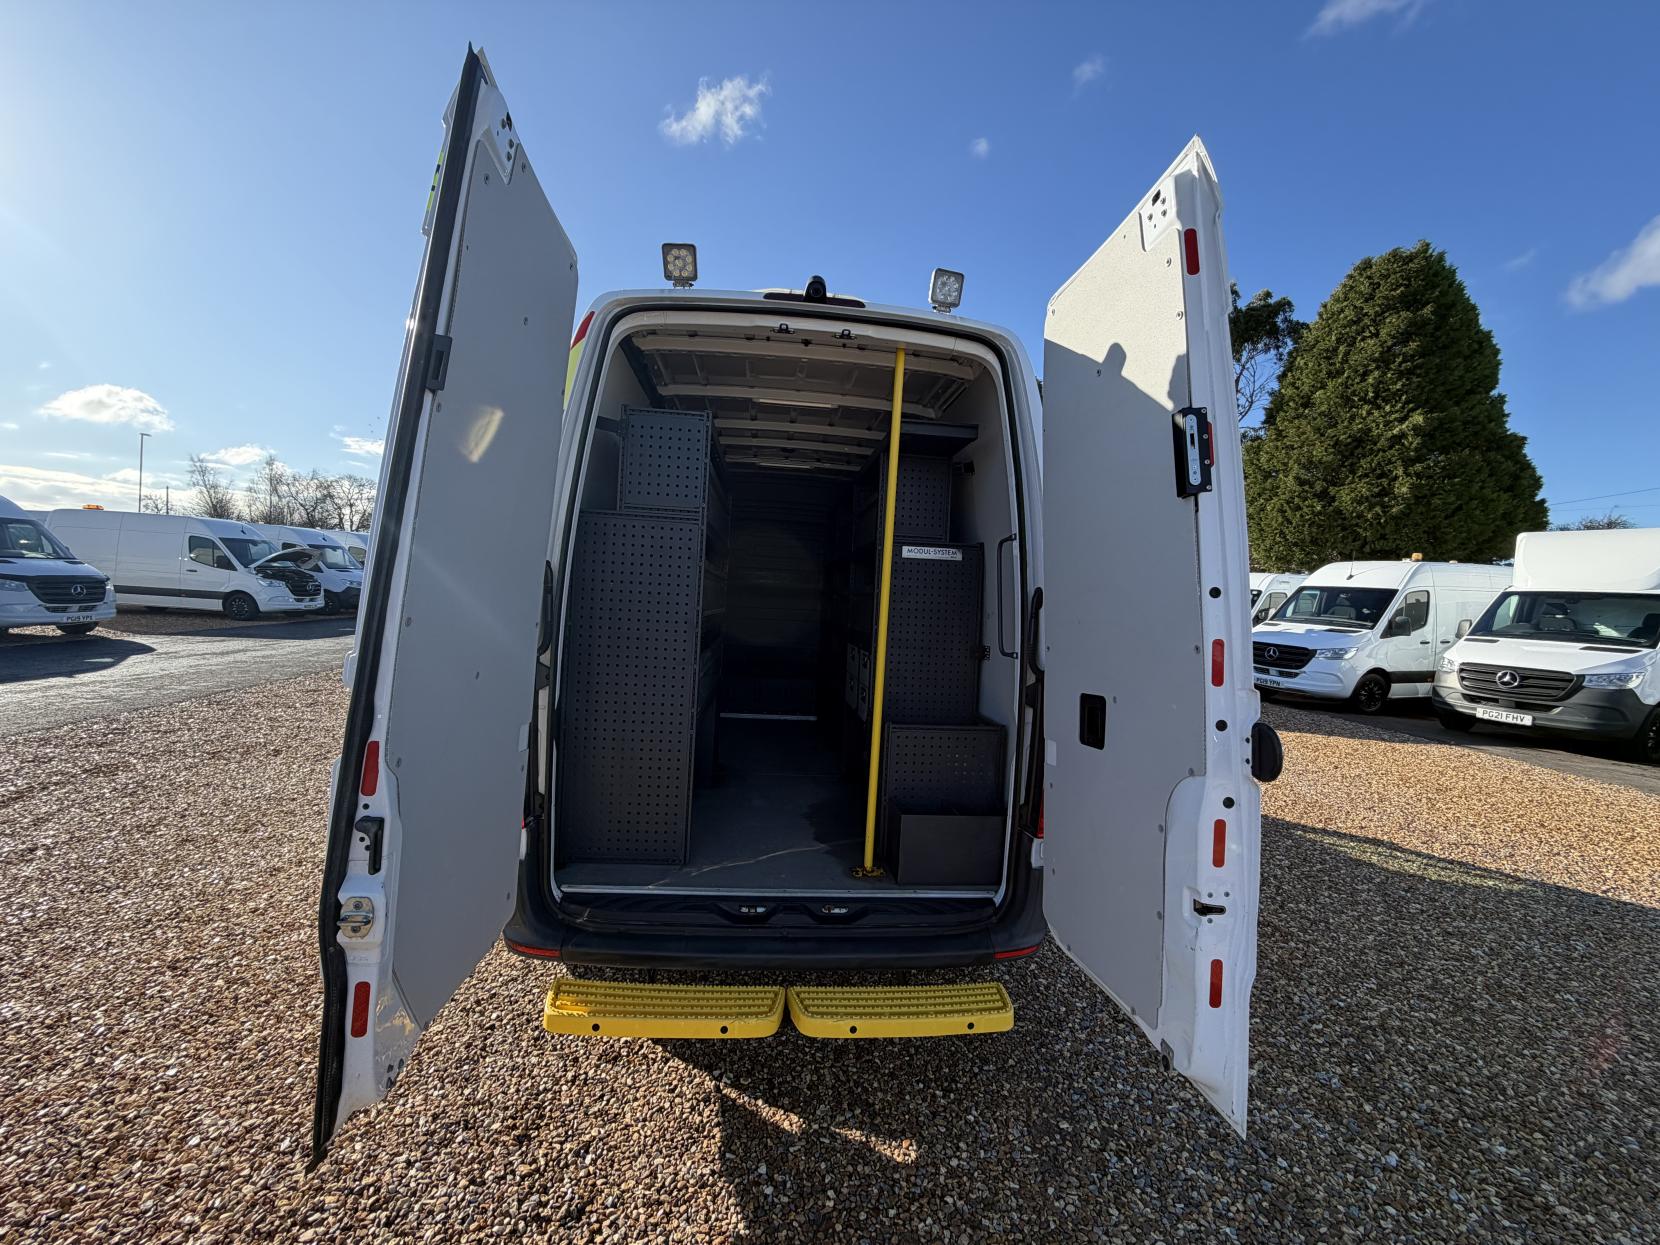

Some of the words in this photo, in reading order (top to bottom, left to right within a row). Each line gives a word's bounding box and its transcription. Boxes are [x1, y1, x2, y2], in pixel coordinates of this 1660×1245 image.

[906, 548, 958, 556] MODUL-SYSTEM
[1482, 709, 1503, 720] PG21
[1505, 713, 1525, 723] FHV
